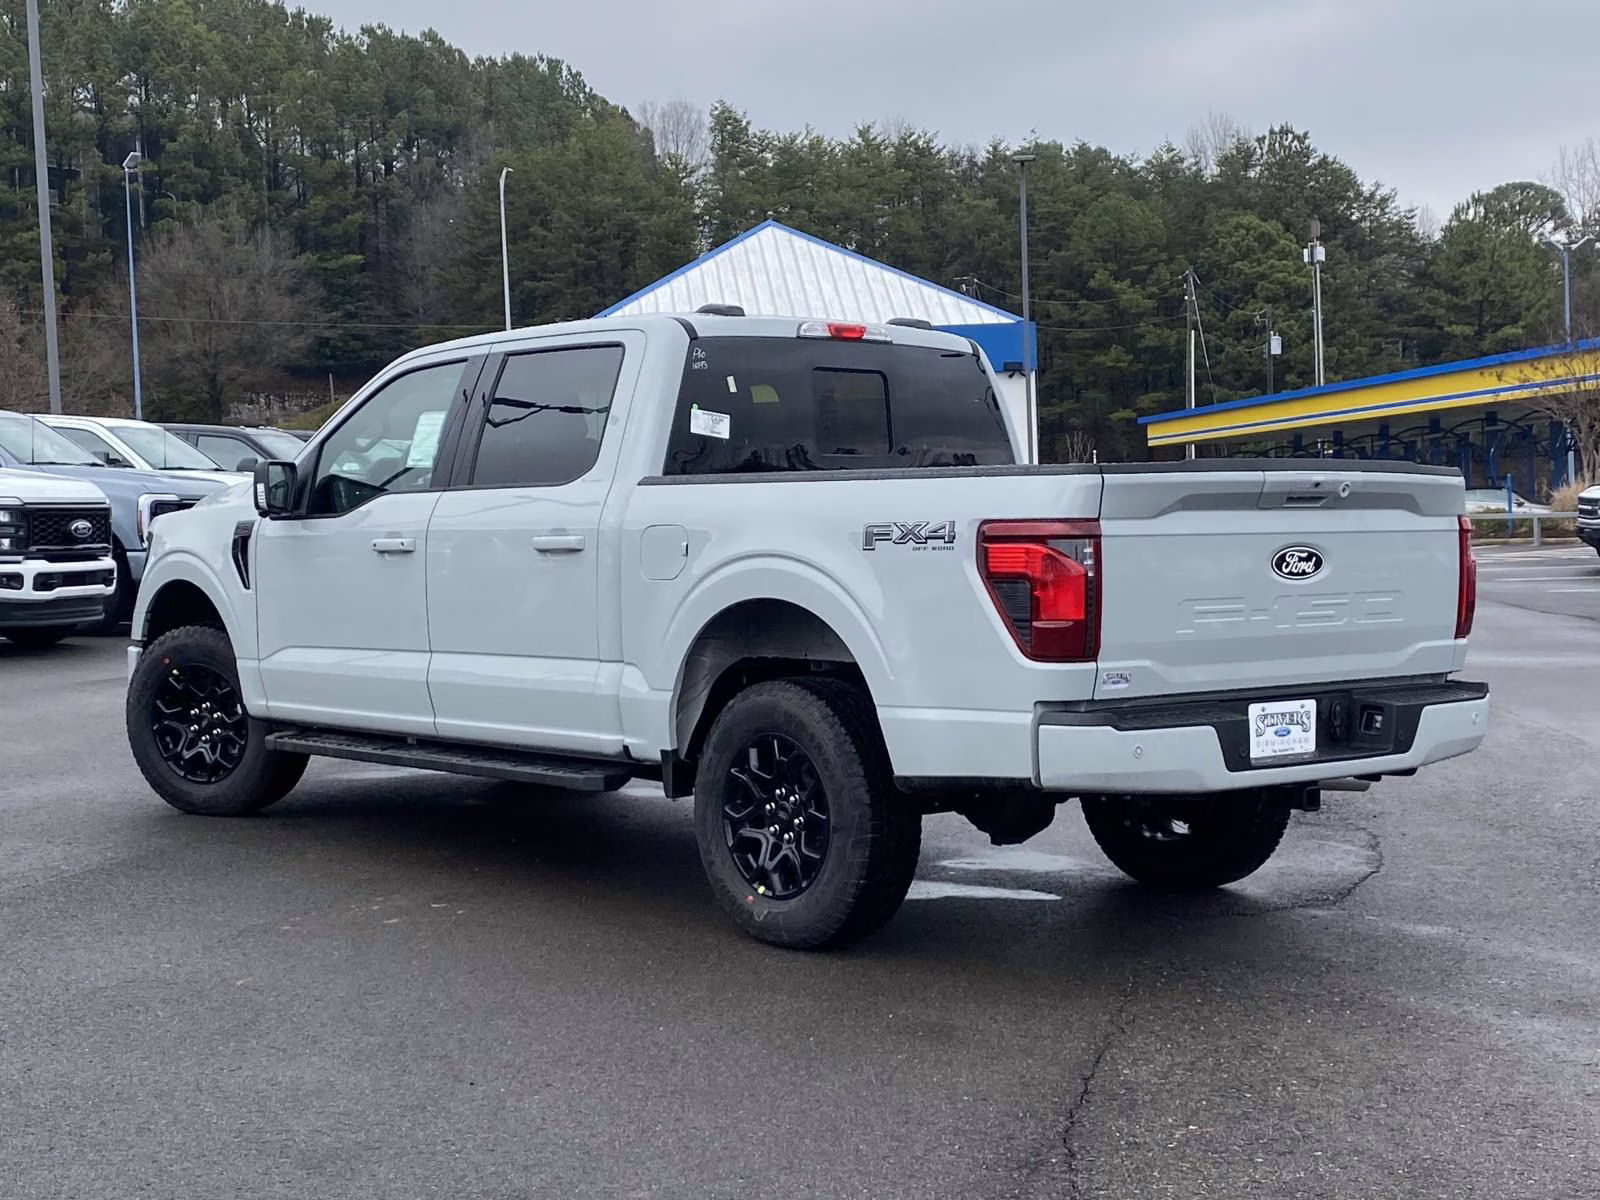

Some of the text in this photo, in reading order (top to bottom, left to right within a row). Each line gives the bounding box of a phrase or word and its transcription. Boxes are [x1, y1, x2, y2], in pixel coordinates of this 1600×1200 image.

[863, 521, 955, 551] FX4
[1282, 551, 1316, 574] Ford
[1176, 590, 1404, 633] F-150
[1255, 710, 1312, 738] STIVERS
[1255, 736, 1310, 749] BIRMINGHAM
